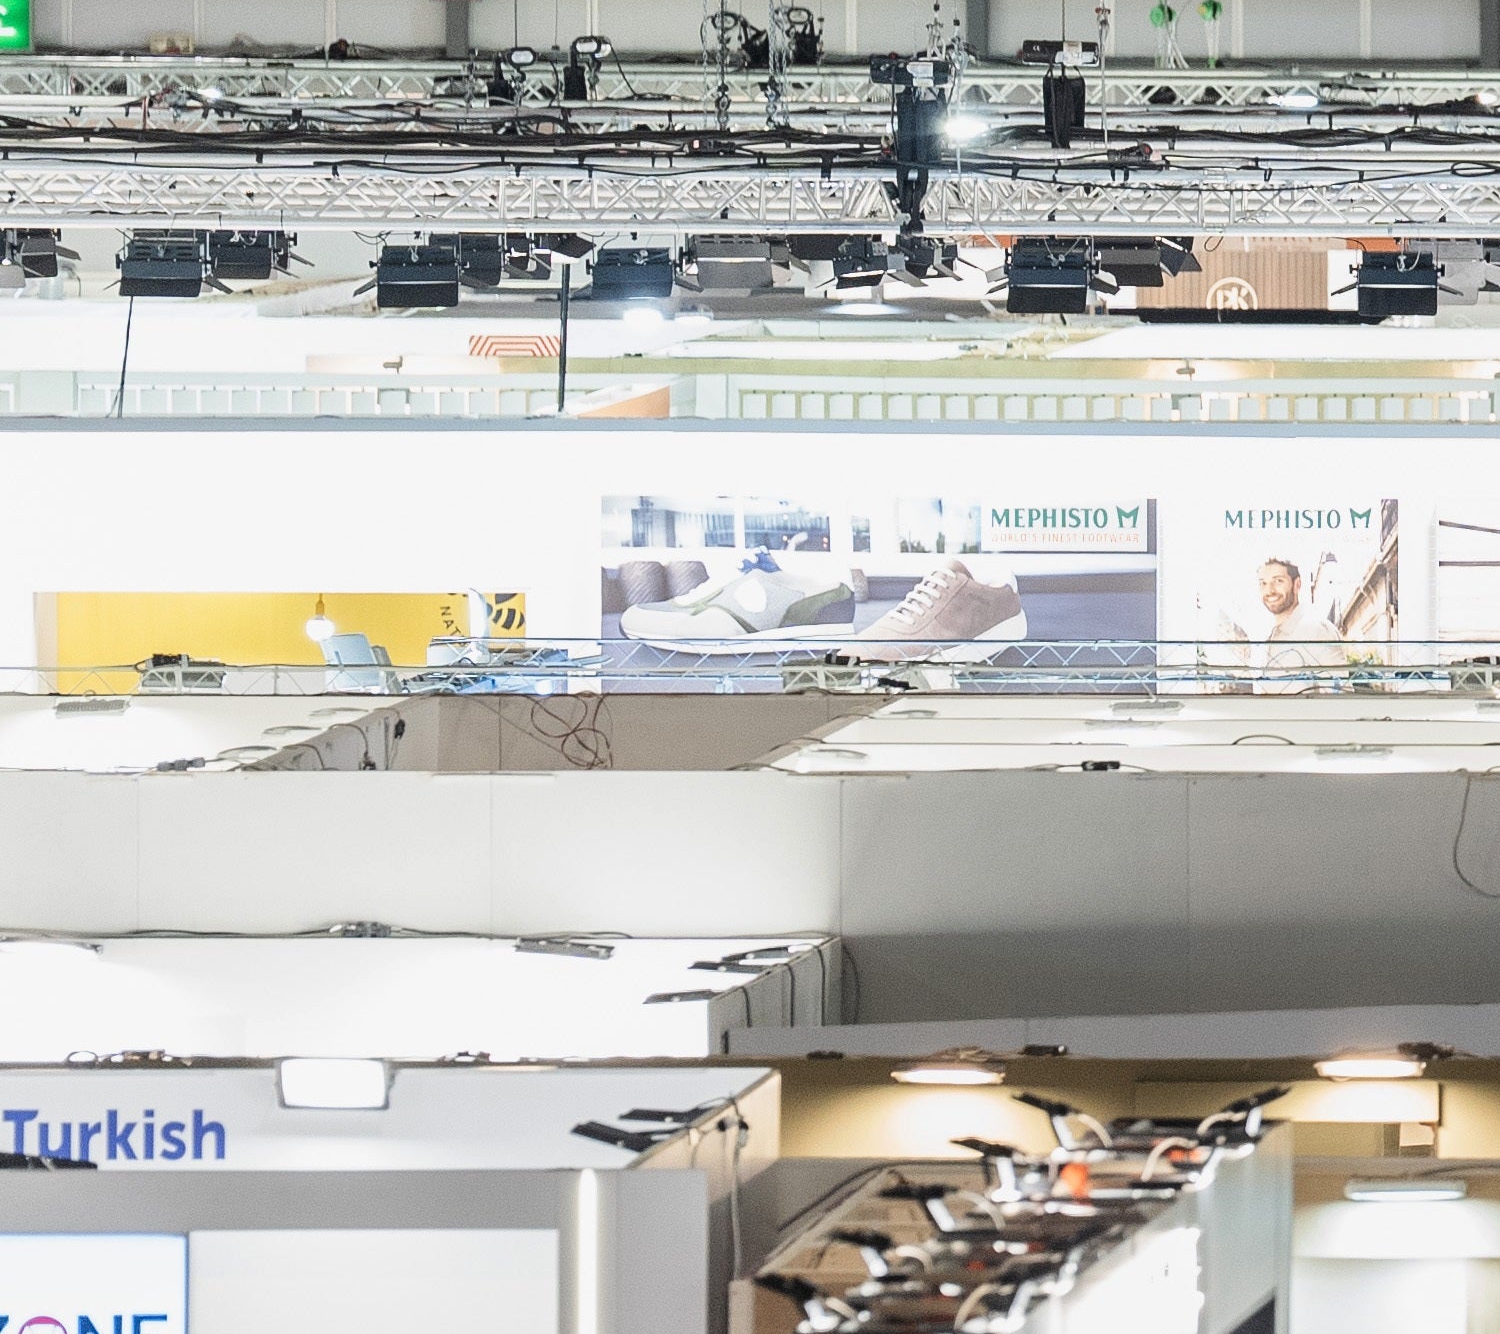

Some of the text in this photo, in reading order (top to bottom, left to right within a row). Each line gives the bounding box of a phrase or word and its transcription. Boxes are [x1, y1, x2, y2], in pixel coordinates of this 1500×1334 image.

[991, 508, 1108, 528] MEPHISTO
[1225, 509, 1341, 529] MEPHISTO
[2, 1109, 226, 1162] Turkish
